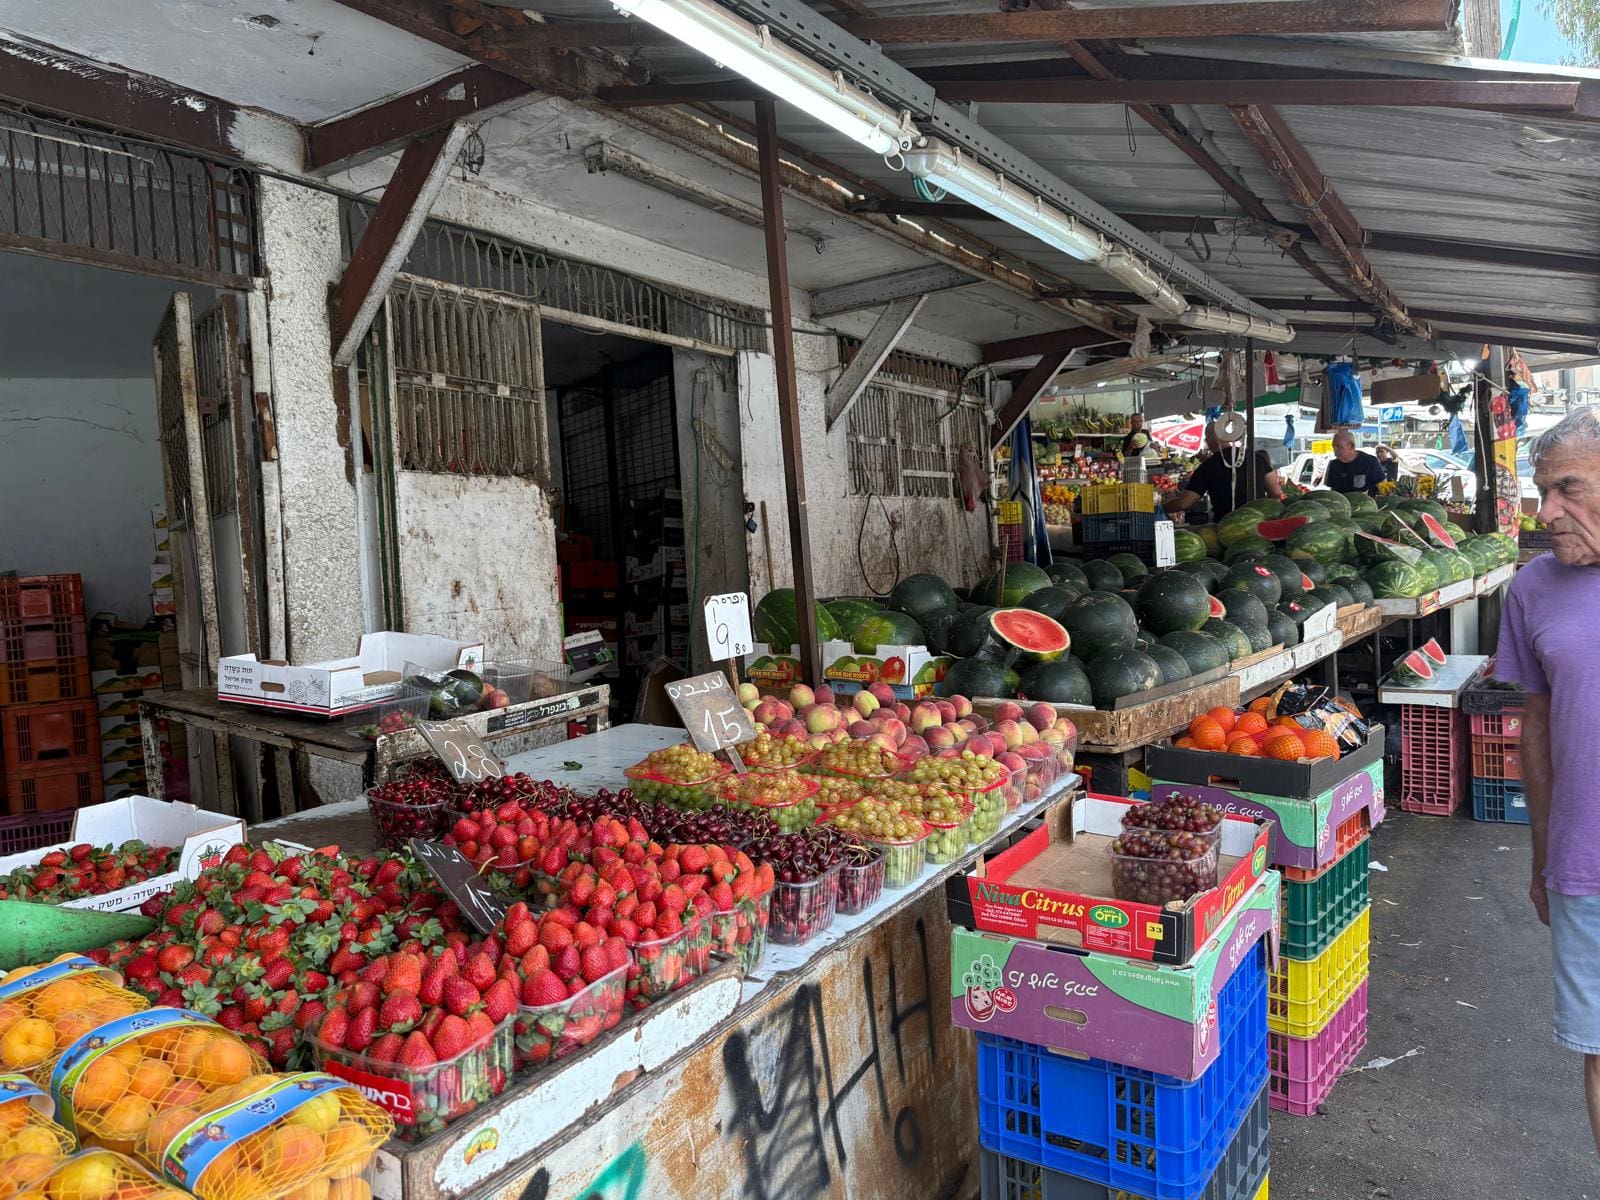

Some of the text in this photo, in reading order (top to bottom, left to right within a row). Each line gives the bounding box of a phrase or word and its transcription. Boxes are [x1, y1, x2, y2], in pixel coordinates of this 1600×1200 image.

[716, 622, 730, 657] 9
[734, 643, 747, 655] 80
[749, 669, 761, 677] Give
[828, 669, 843, 677] Give
[853, 671, 870, 680] more
[669, 675, 723, 699] ענבים
[703, 705, 742, 750] 15
[444, 740, 501, 779] 28
[420, 843, 468, 865] תות
[98, 897, 123, 913] משק
[975, 882, 1021, 906] Niva
[1021, 889, 1085, 918] Citrus
[1095, 909, 1122, 924] Orri
[1064, 981, 1099, 997] זהב
